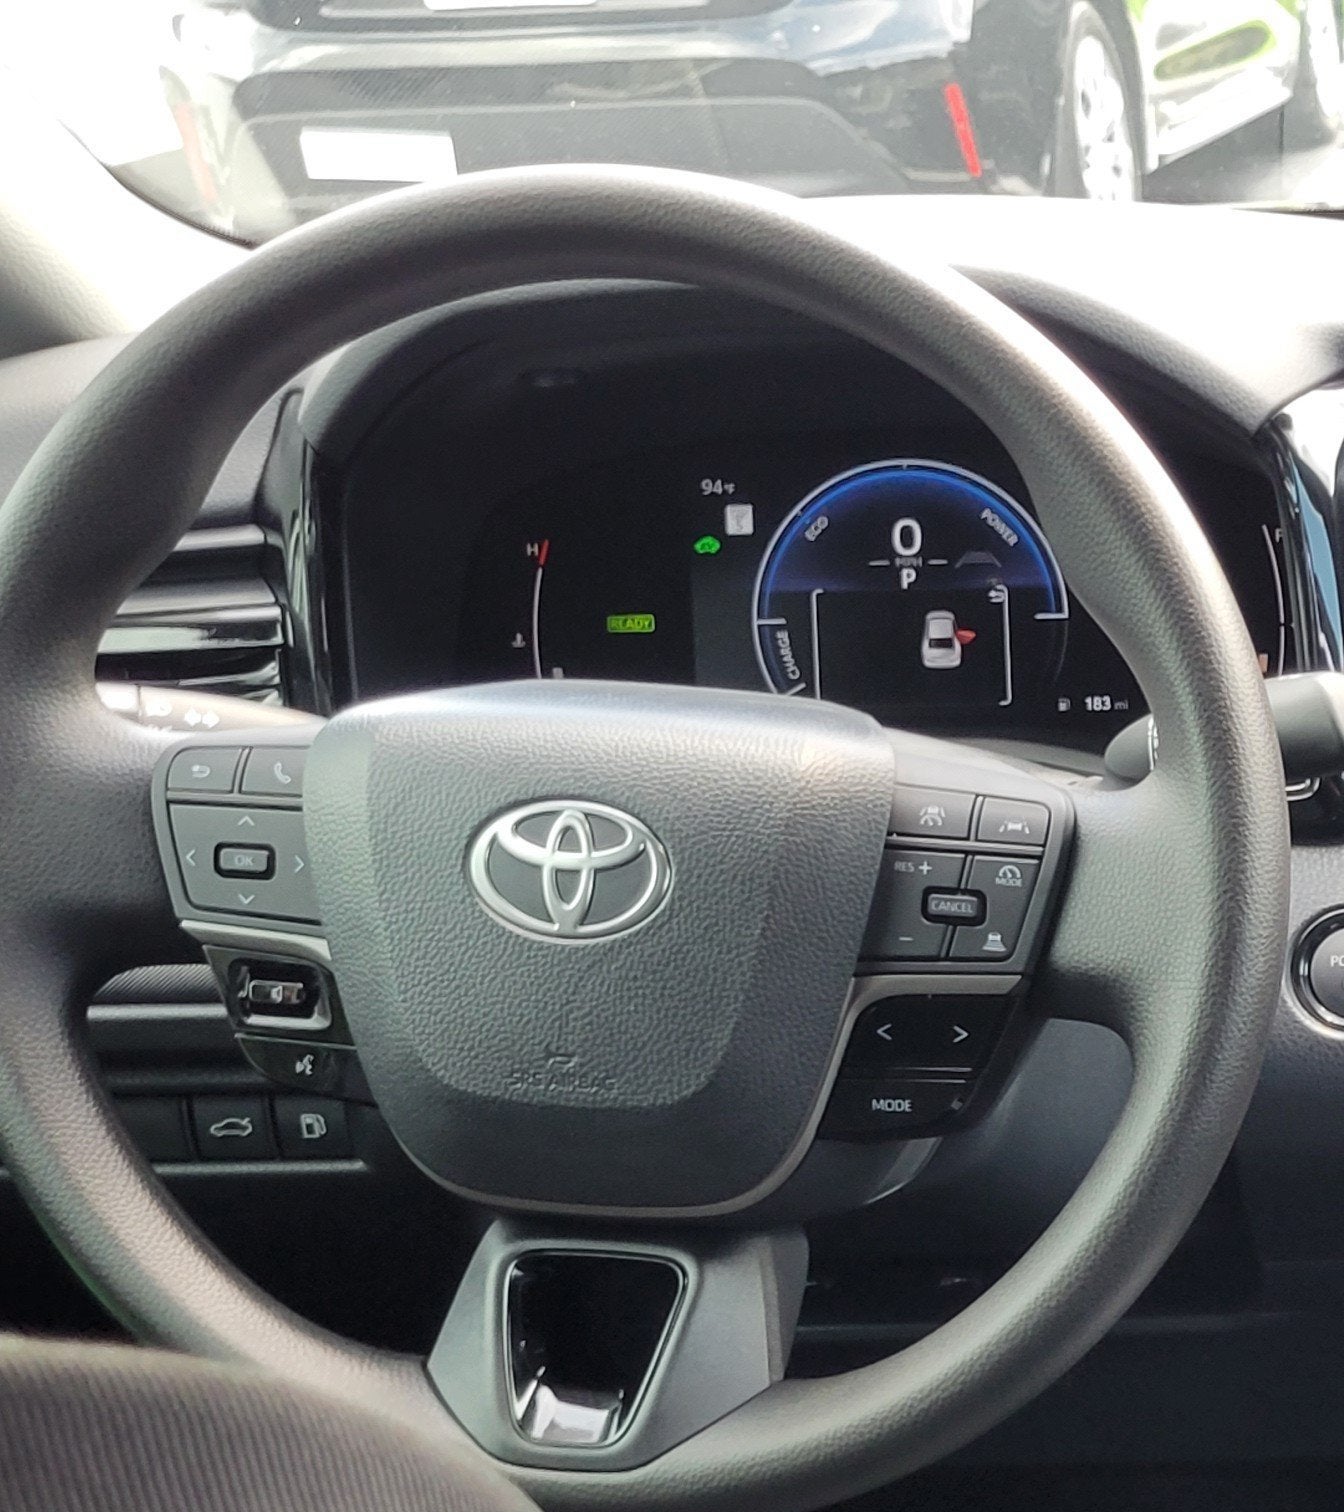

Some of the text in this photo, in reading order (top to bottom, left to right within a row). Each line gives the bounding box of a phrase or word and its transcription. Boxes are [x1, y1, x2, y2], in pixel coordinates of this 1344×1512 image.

[804, 515, 829, 542] ECO
[980, 507, 1019, 547] POWER
[527, 543, 539, 557] H
[901, 568, 917, 590] P
[610, 617, 651, 630] READY
[775, 629, 800, 680] CHARGE
[1084, 695, 1112, 712] 183
[236, 855, 255, 866] OK
[893, 861, 915, 873] RES
[931, 900, 973, 913] CANCEL
[871, 1098, 914, 1113] MODE
